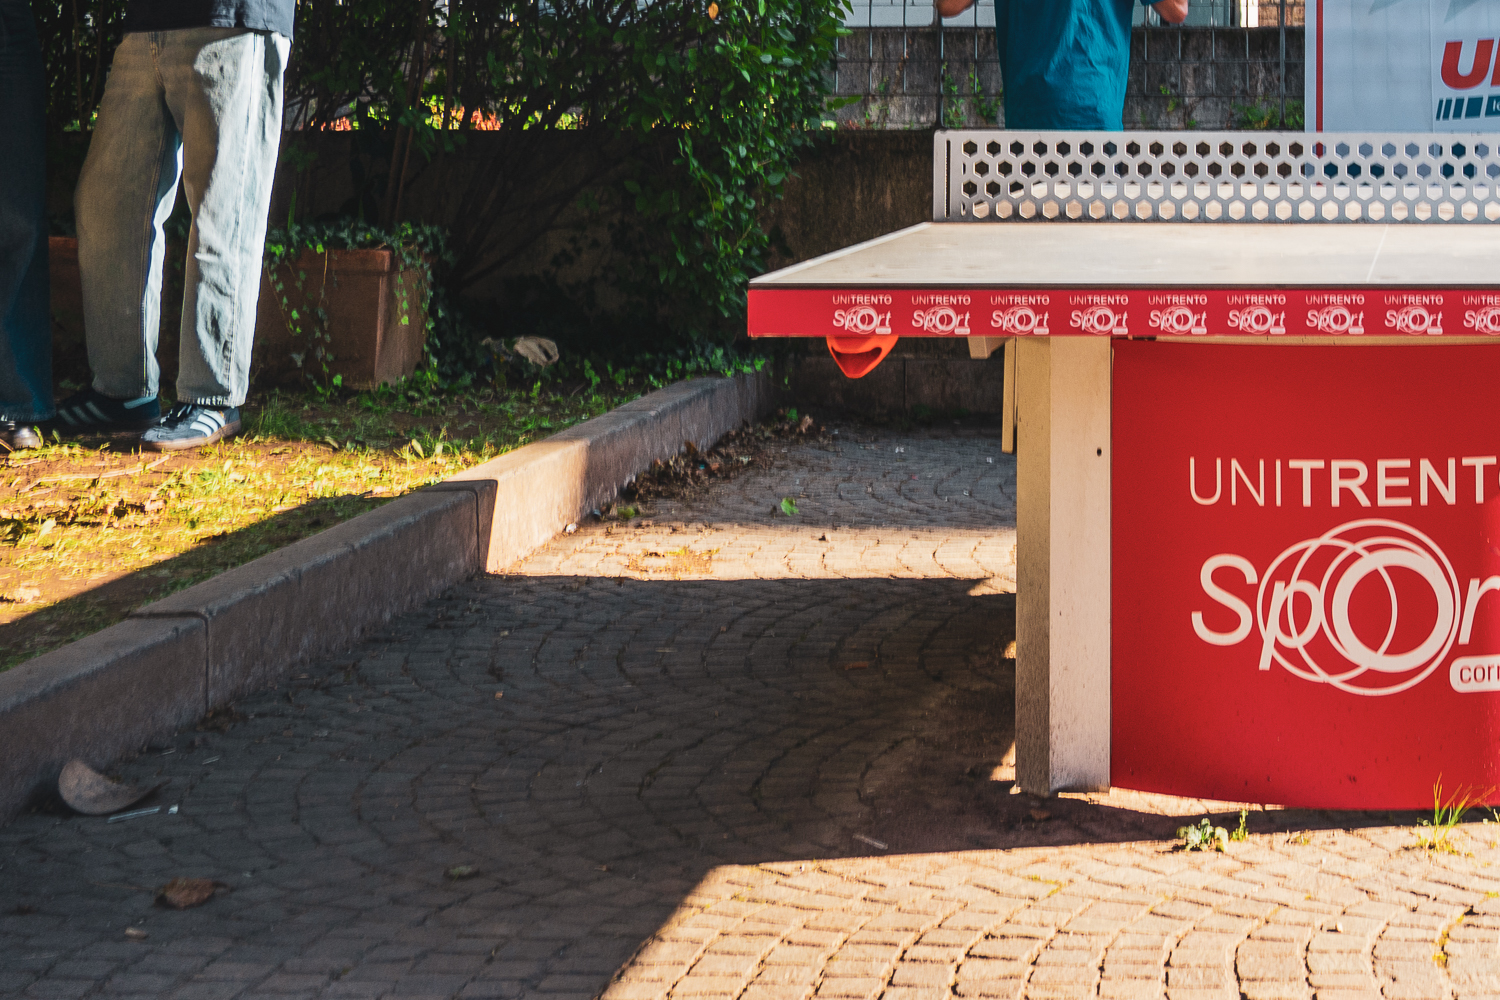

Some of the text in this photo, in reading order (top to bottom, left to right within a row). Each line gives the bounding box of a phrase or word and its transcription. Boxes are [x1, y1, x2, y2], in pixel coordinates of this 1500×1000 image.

[832, 294, 893, 306] UNITRENTO
[911, 294, 971, 306] UNITRENTO
[990, 294, 1050, 306] UNITRENTO
[1069, 294, 1129, 306] UNITRENTO
[1148, 294, 1208, 306] UNITRENTO
[1226, 294, 1287, 306] UNITRENTO
[1305, 294, 1365, 306] UNITRENTO
[1384, 294, 1444, 306] UNITRENTO
